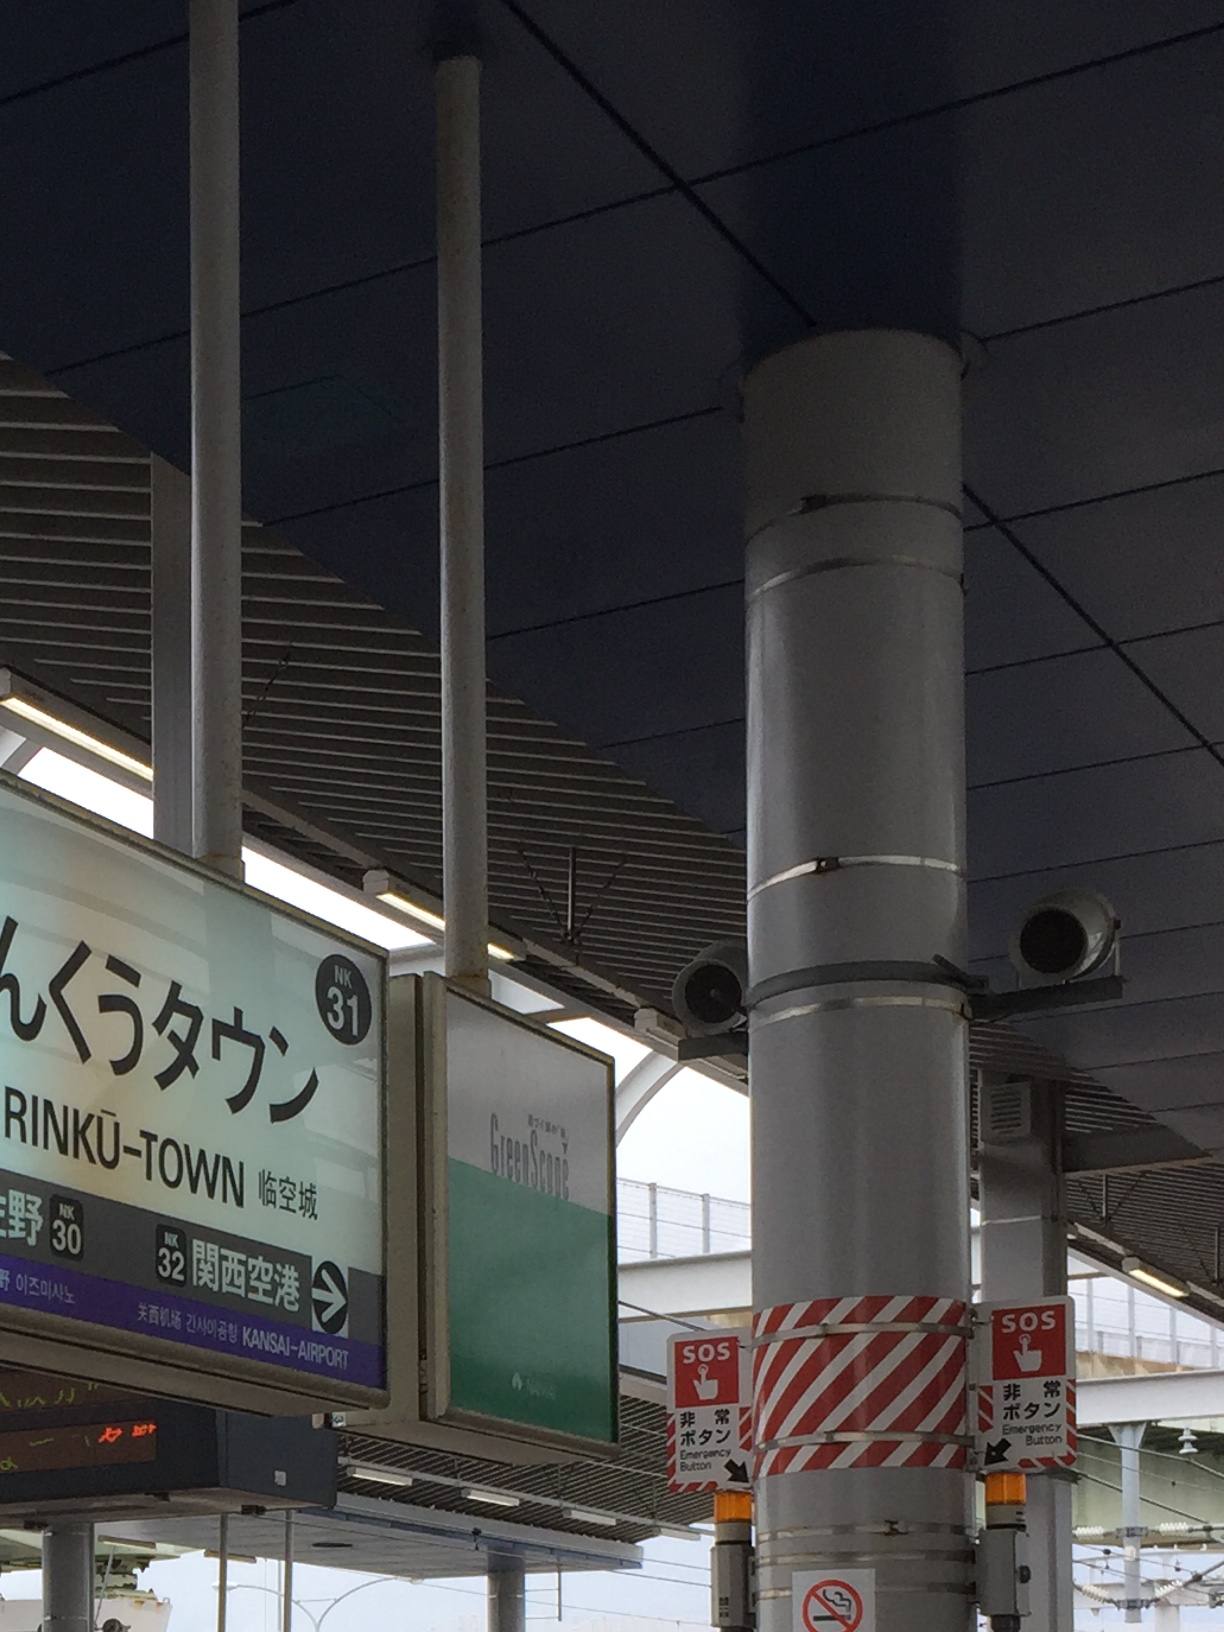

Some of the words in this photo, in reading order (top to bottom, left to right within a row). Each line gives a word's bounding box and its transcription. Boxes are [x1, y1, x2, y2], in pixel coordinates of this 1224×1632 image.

[334, 965, 353, 989] NK
[326, 985, 359, 1037] 31
[5, 1085, 244, 1208] RINKŪ-TOWN
[258, 1169, 318, 1220] 临空城
[59, 1202, 75, 1220] NK
[51, 1219, 81, 1255] 30
[164, 1231, 179, 1249] NK
[157, 1247, 184, 1282] 32
[192, 1238, 300, 1313] 関西空港
[15, 1273, 75, 1304] 이즈미사노
[1001, 1310, 1056, 1334] SOS
[242, 1326, 349, 1371] KANSAI-AIRPORT
[682, 1342, 731, 1364] SOS
[1002, 1380, 1062, 1401] 非常
[680, 1409, 731, 1429] 非常
[1002, 1402, 1061, 1421] ボタン
[680, 1429, 731, 1446] ボタン
[1001, 1421, 1062, 1437] Emergency
[1025, 1434, 1063, 1446] Button
[679, 1448, 731, 1462] Emergency
[680, 1460, 712, 1472] Button
